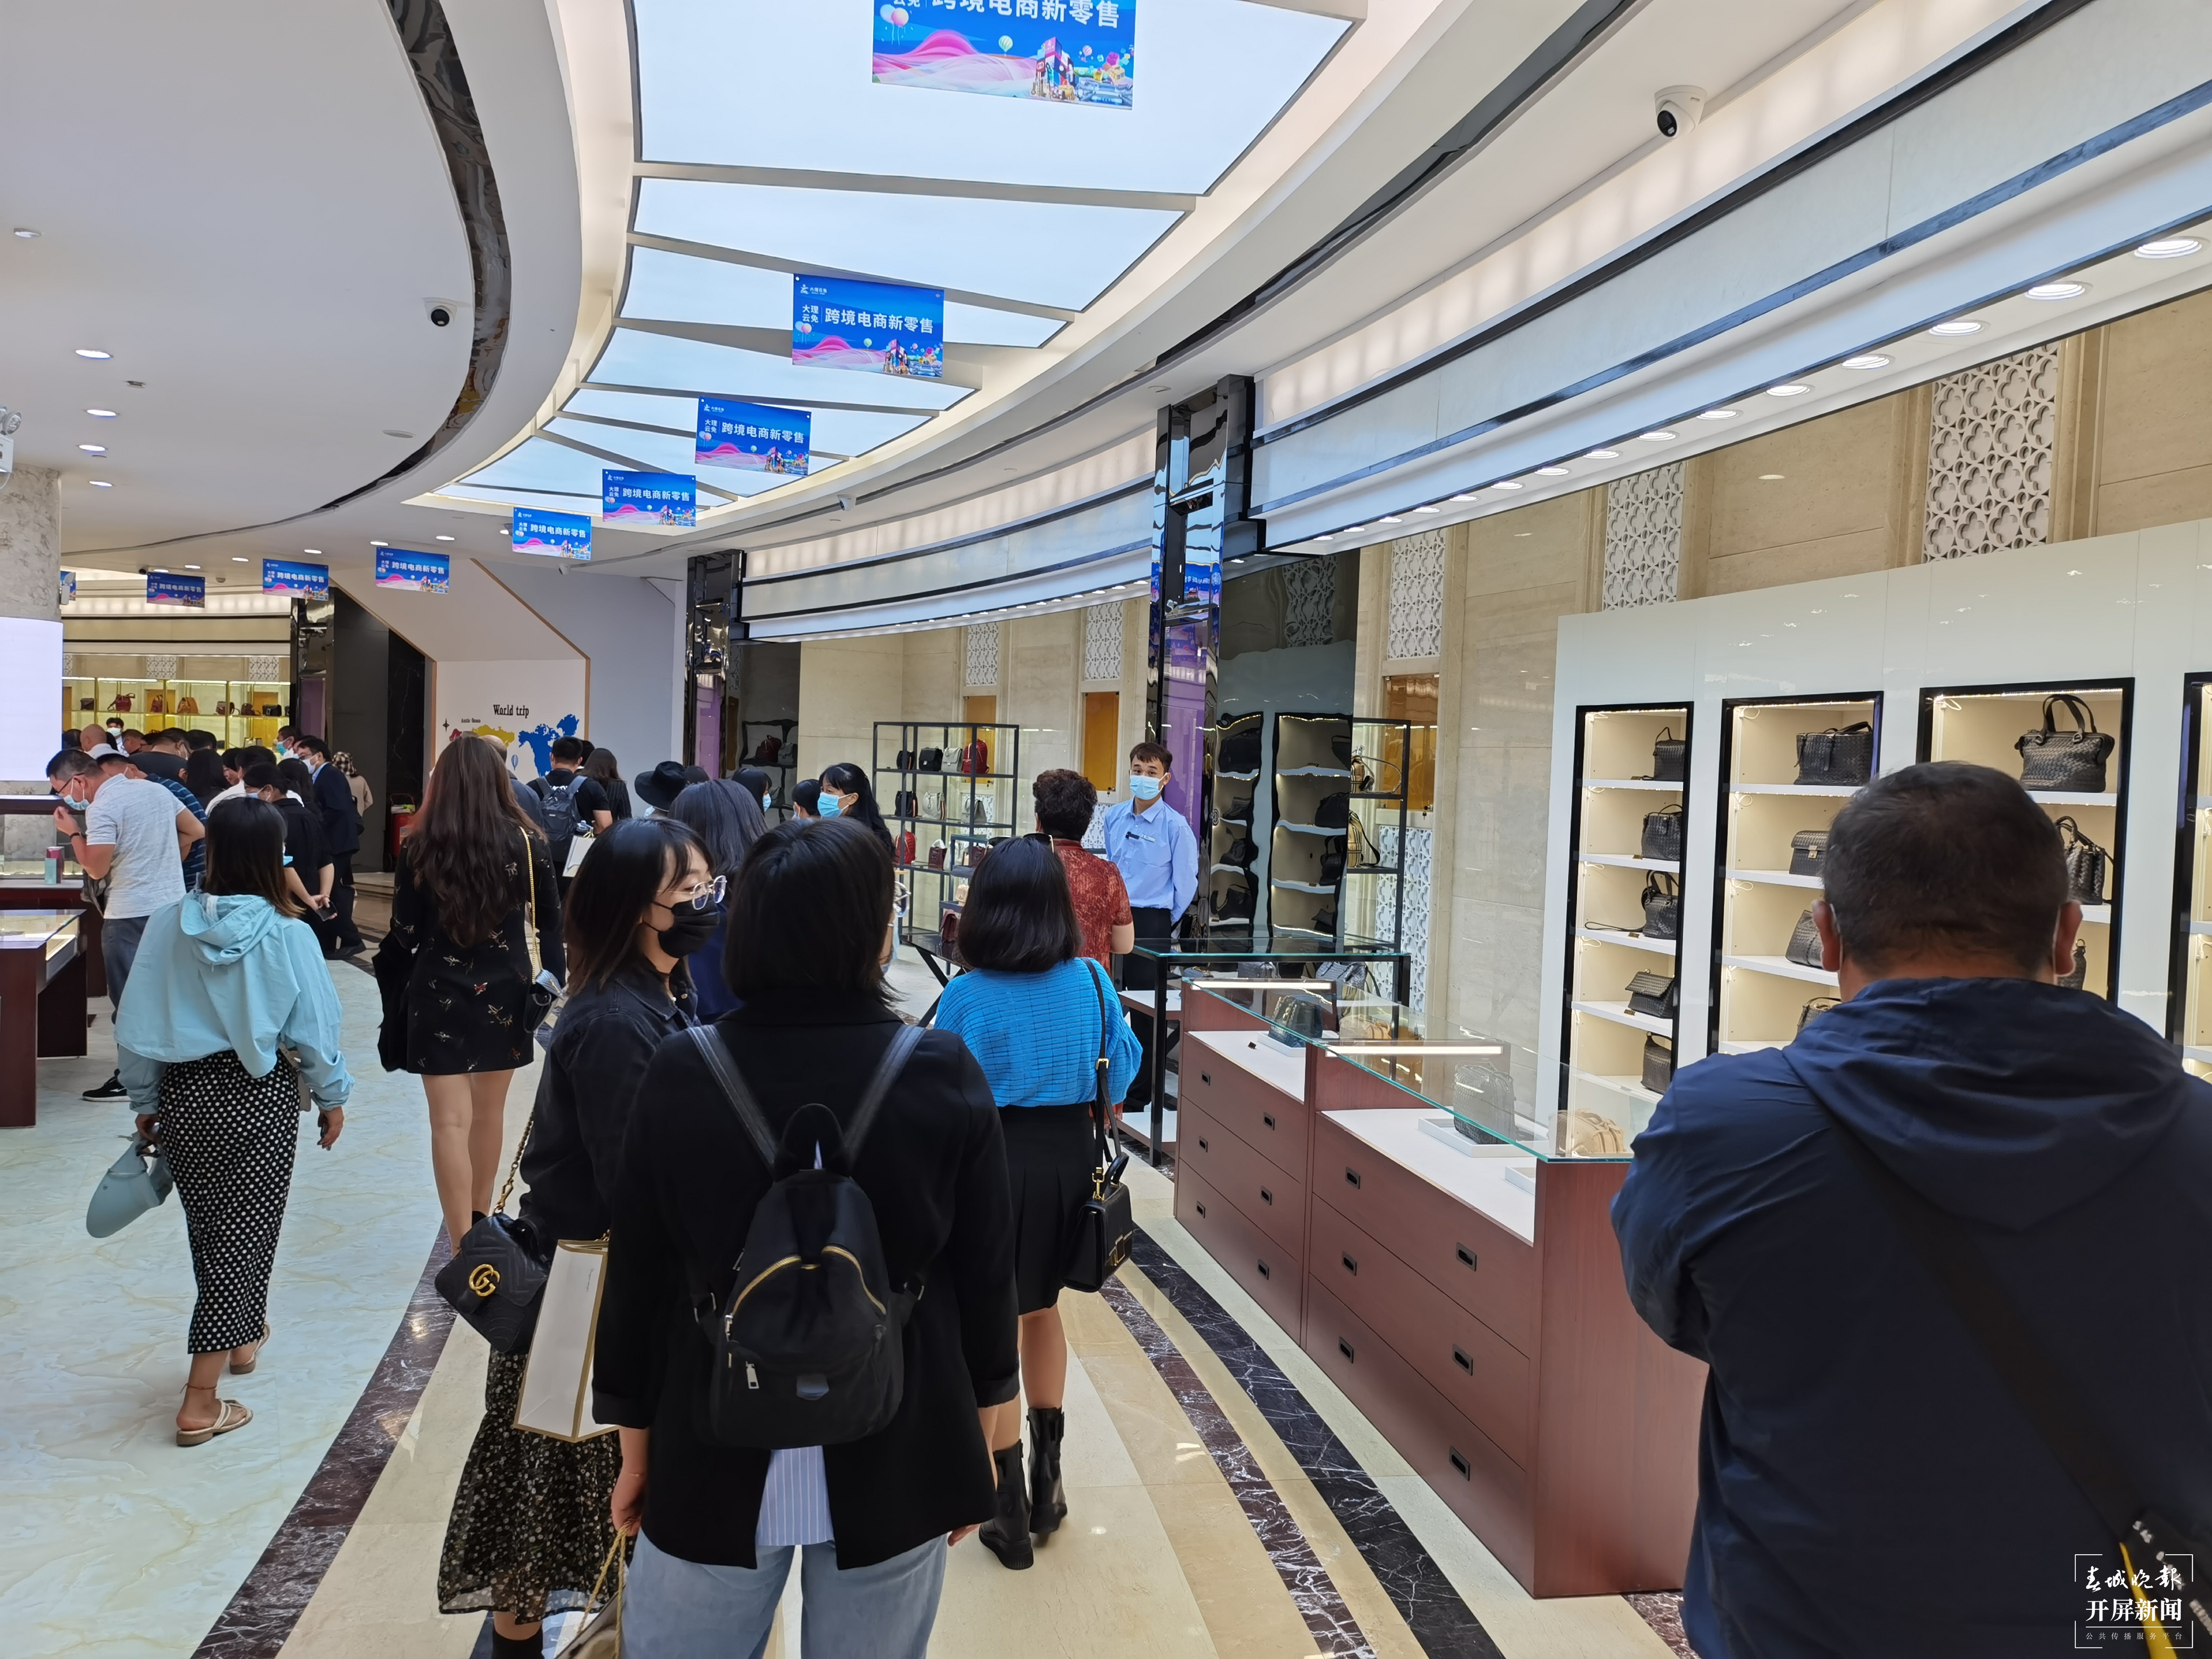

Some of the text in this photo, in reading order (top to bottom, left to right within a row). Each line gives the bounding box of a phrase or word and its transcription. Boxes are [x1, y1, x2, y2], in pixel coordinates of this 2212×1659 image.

[802, 304, 819, 314] 大理
[802, 314, 819, 323] 云免
[825, 307, 934, 334] 跨境电商新零售
[705, 419, 718, 427] 大理
[721, 422, 804, 444] 跨境电商新零售
[623, 488, 690, 501] 跨境电商新零售
[530, 524, 586, 538] 跨境电商新零售
[392, 561, 444, 575] 跨境电商新零售
[493, 704, 529, 718] World trip
